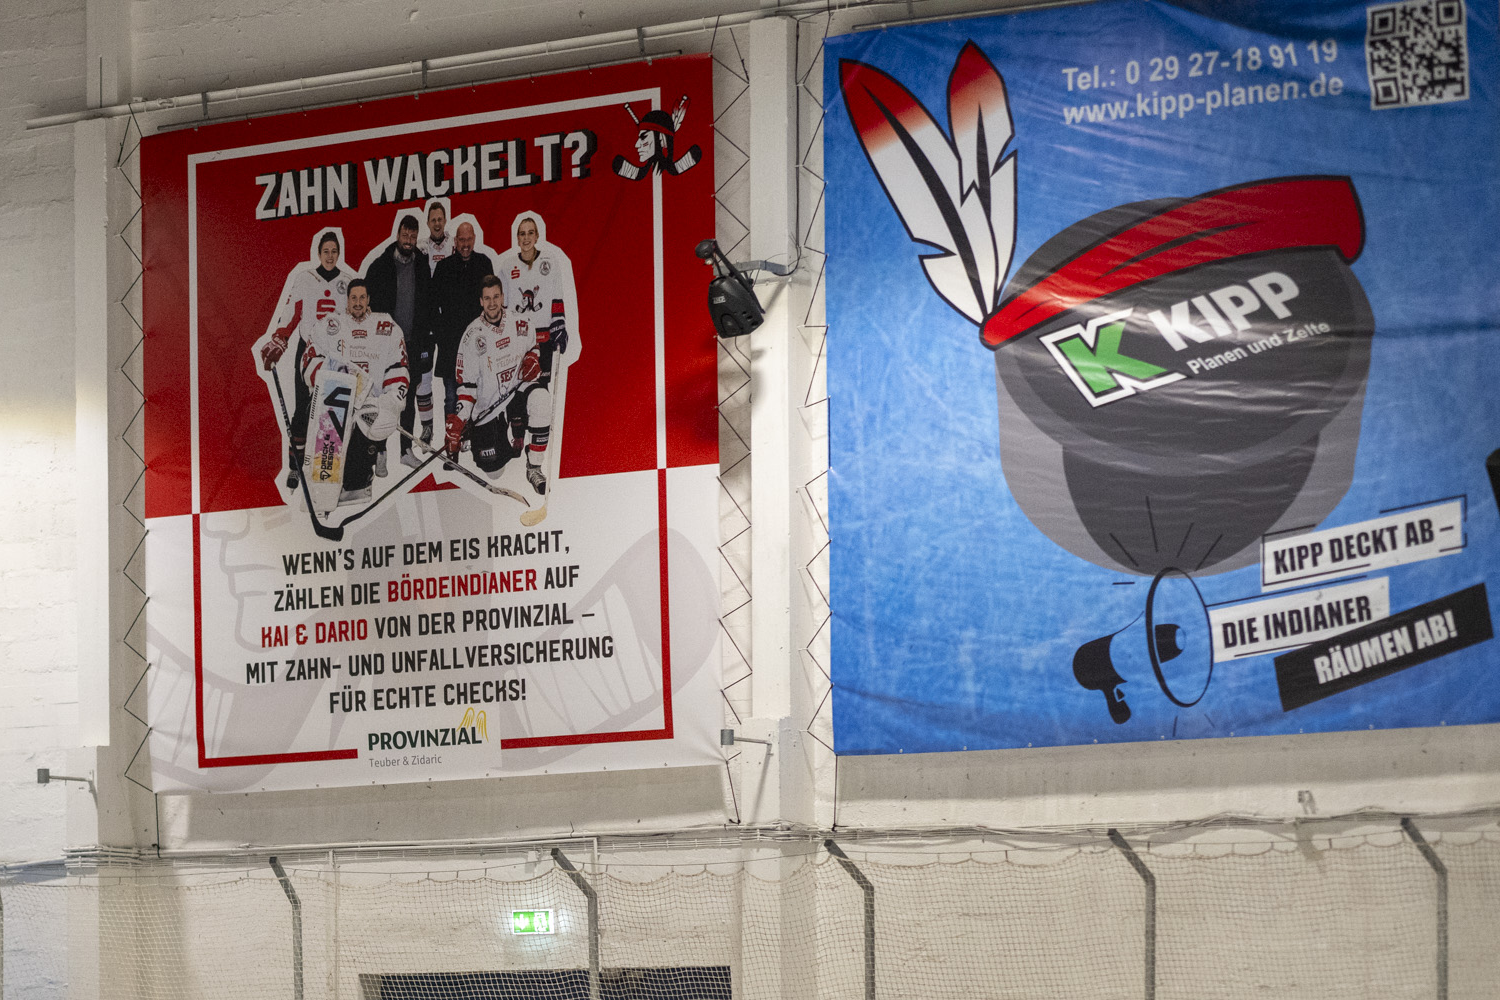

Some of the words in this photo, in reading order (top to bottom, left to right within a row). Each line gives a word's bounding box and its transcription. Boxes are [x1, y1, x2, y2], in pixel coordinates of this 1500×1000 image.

[1062, 64, 1116, 92] Tel.:
[1125, 61, 1140, 85] 0
[1148, 57, 1179, 82] 29
[1187, 48, 1262, 78] 27-18
[1270, 45, 1298, 69] 91
[1306, 39, 1339, 65] 19
[1062, 72, 1344, 125] www.kipp-planen.de
[255, 163, 354, 220] ZAHN
[364, 131, 592, 205] WACKELT?
[1148, 271, 1300, 351] KIPP
[1187, 345, 1244, 377] Planen
[1247, 334, 1283, 357] und
[1285, 318, 1332, 346] Zelte
[361, 543, 396, 569] AUF
[402, 540, 443, 566] DEM
[449, 537, 480, 562] EIS
[487, 530, 571, 559] KRACHT,
[1273, 540, 1325, 576] KIPP
[1330, 525, 1399, 564] DECKT
[1405, 517, 1435, 547] AB
[274, 583, 345, 612] ZÄHLEN
[351, 582, 381, 607] DIE
[387, 569, 538, 603] BÖRDEINDIANER
[544, 565, 580, 590] AUF
[261, 624, 289, 649] KAI
[295, 622, 308, 645] &
[315, 619, 368, 644] DARIO
[374, 615, 412, 640] VON
[418, 612, 456, 637] DER
[461, 603, 575, 634] PROVINZIAL
[1222, 616, 1260, 649] DIE
[1264, 595, 1372, 639] INDIANER
[1313, 627, 1413, 685] RÄUMEN
[1415, 609, 1458, 651] AB!
[245, 661, 277, 685] MIT
[285, 656, 342, 682] ZAHN-
[347, 652, 385, 677] UND
[391, 636, 615, 674] UNFALLVERSICHERUNG
[329, 685, 367, 714] FÜR
[373, 685, 437, 711] ECHTE
[443, 678, 527, 706] CHECKS!
[367, 726, 483, 751] PROVINZIAL
[368, 757, 400, 768] Teuber
[412, 754, 442, 765] Zidaric
